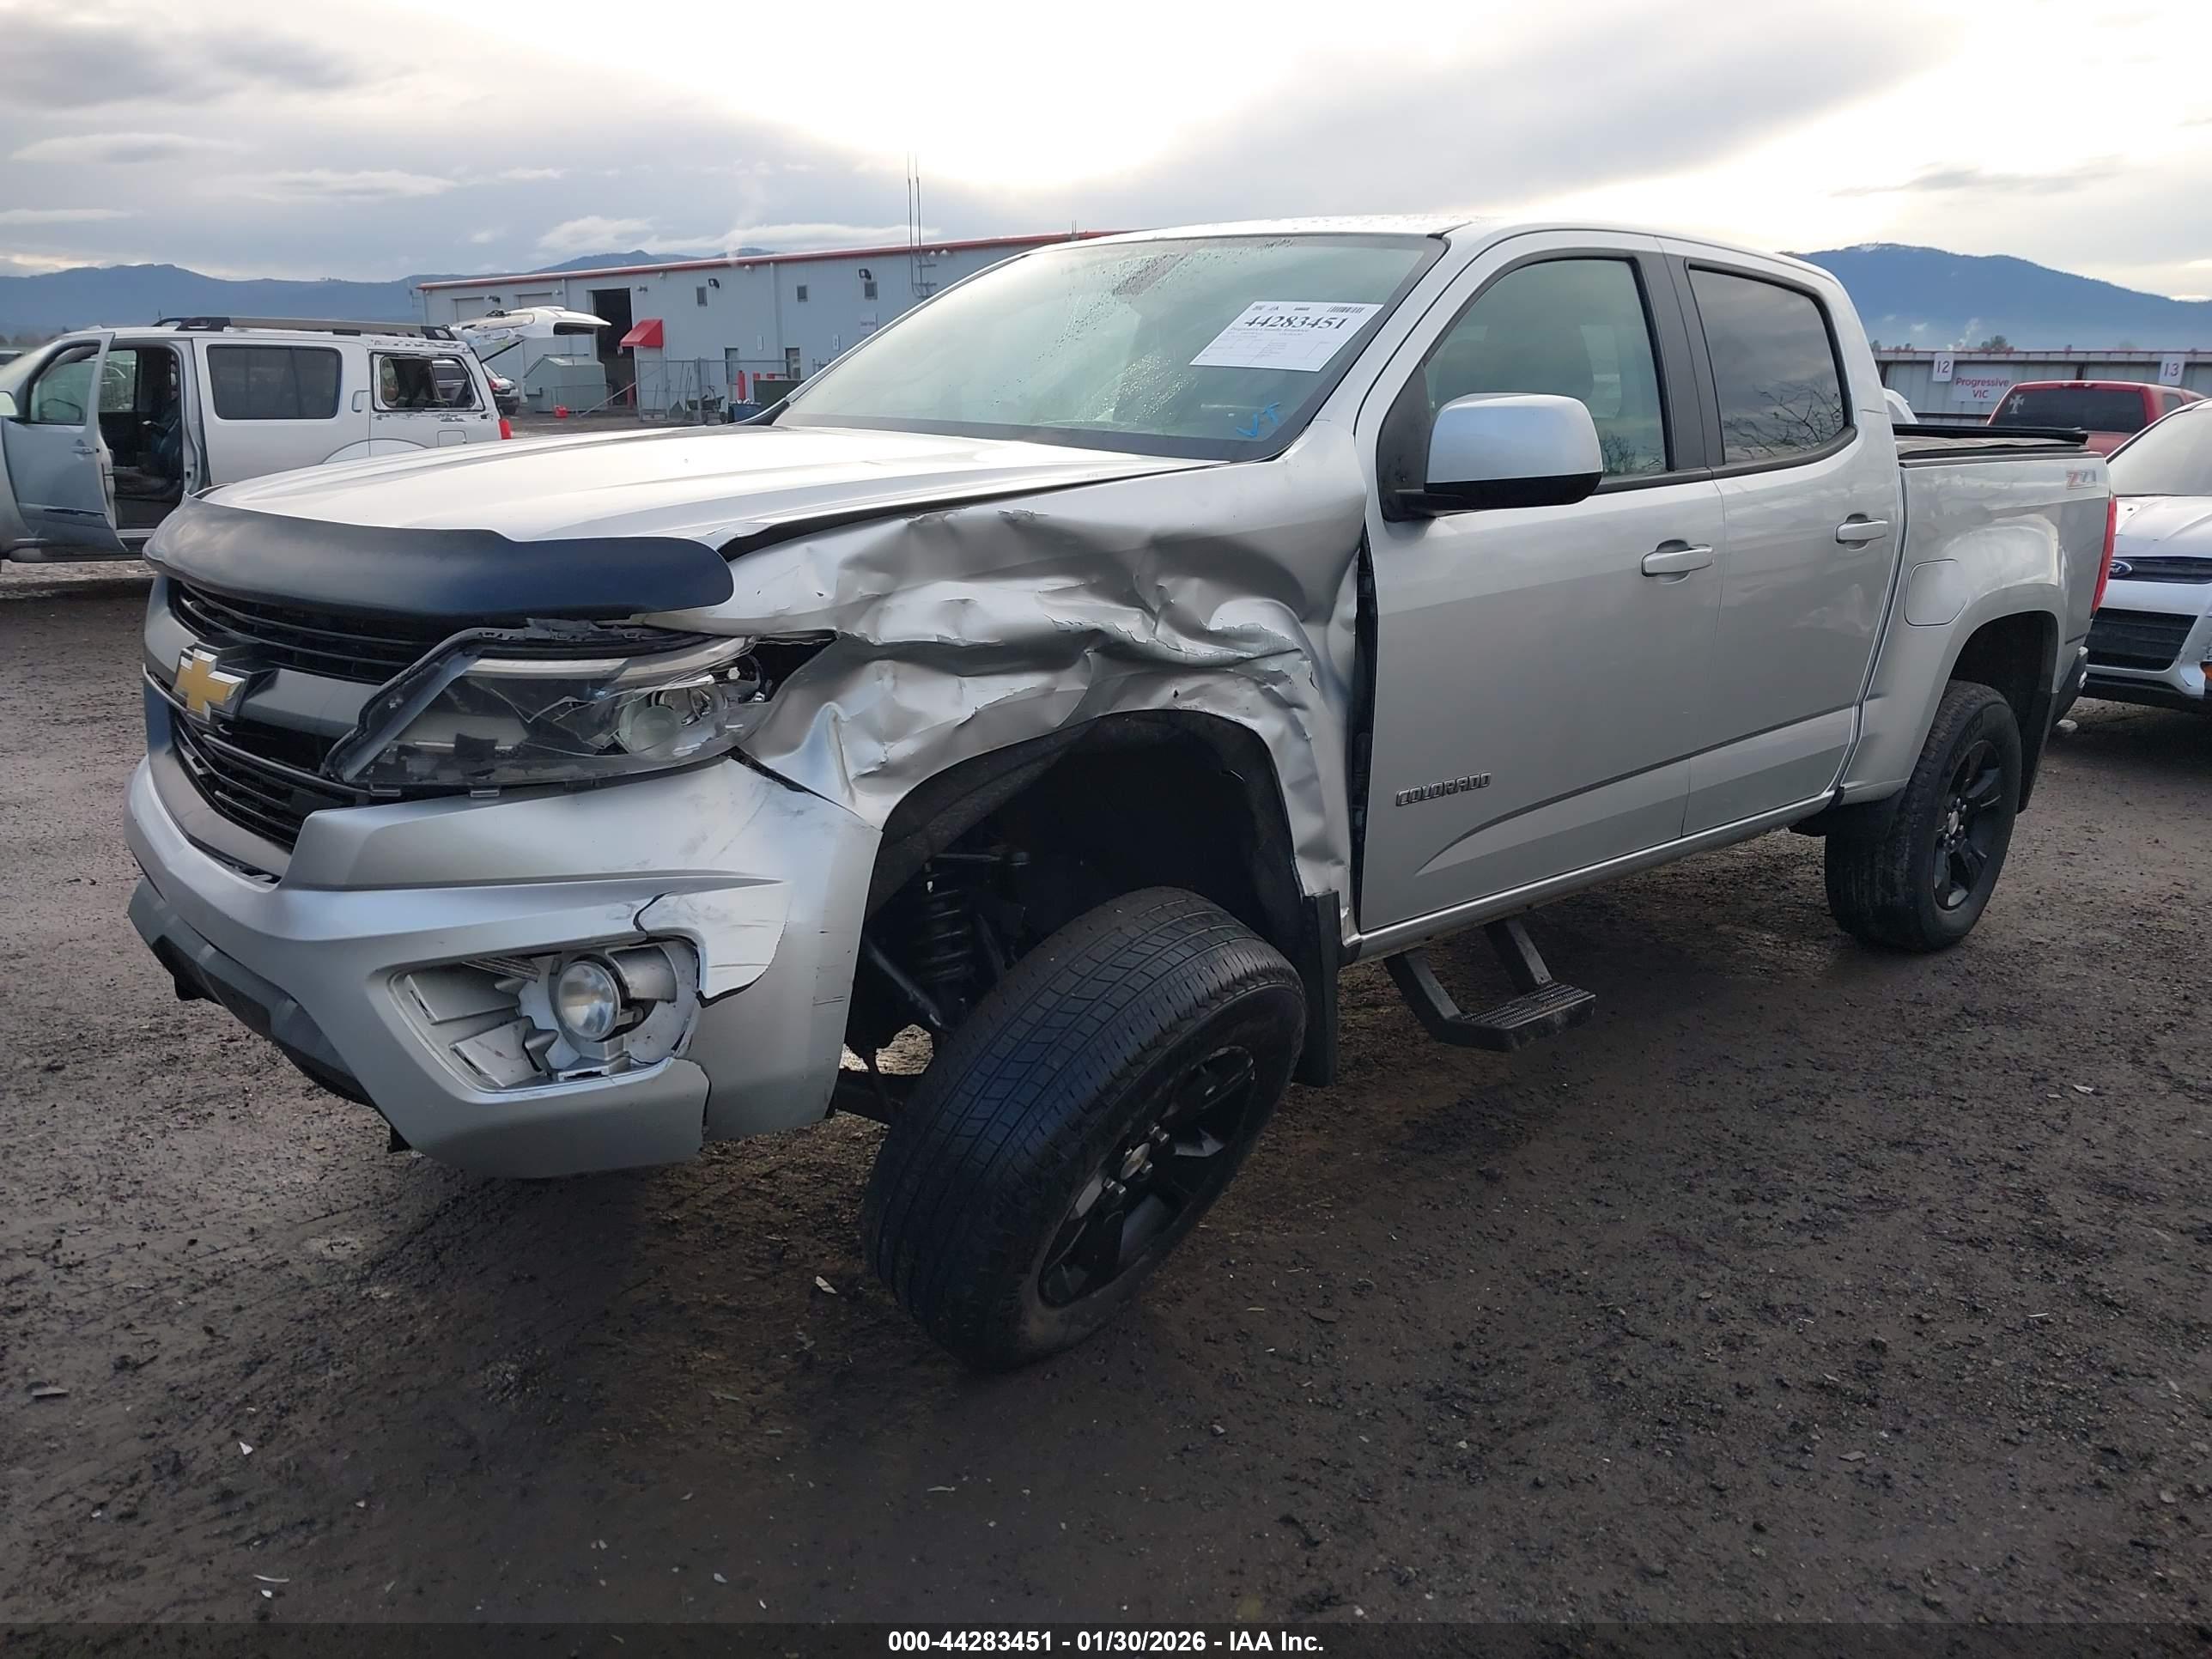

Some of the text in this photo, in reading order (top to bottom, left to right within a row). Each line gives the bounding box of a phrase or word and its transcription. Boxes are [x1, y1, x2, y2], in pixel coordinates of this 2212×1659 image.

[1244, 315, 1348, 329] 44283451
[1937, 361, 1949, 373] 12
[2164, 362, 2179, 377] 13
[1955, 377, 2009, 387] Progressive
[1972, 390, 1989, 398] VIC
[1395, 772, 1492, 807] COLORADO
